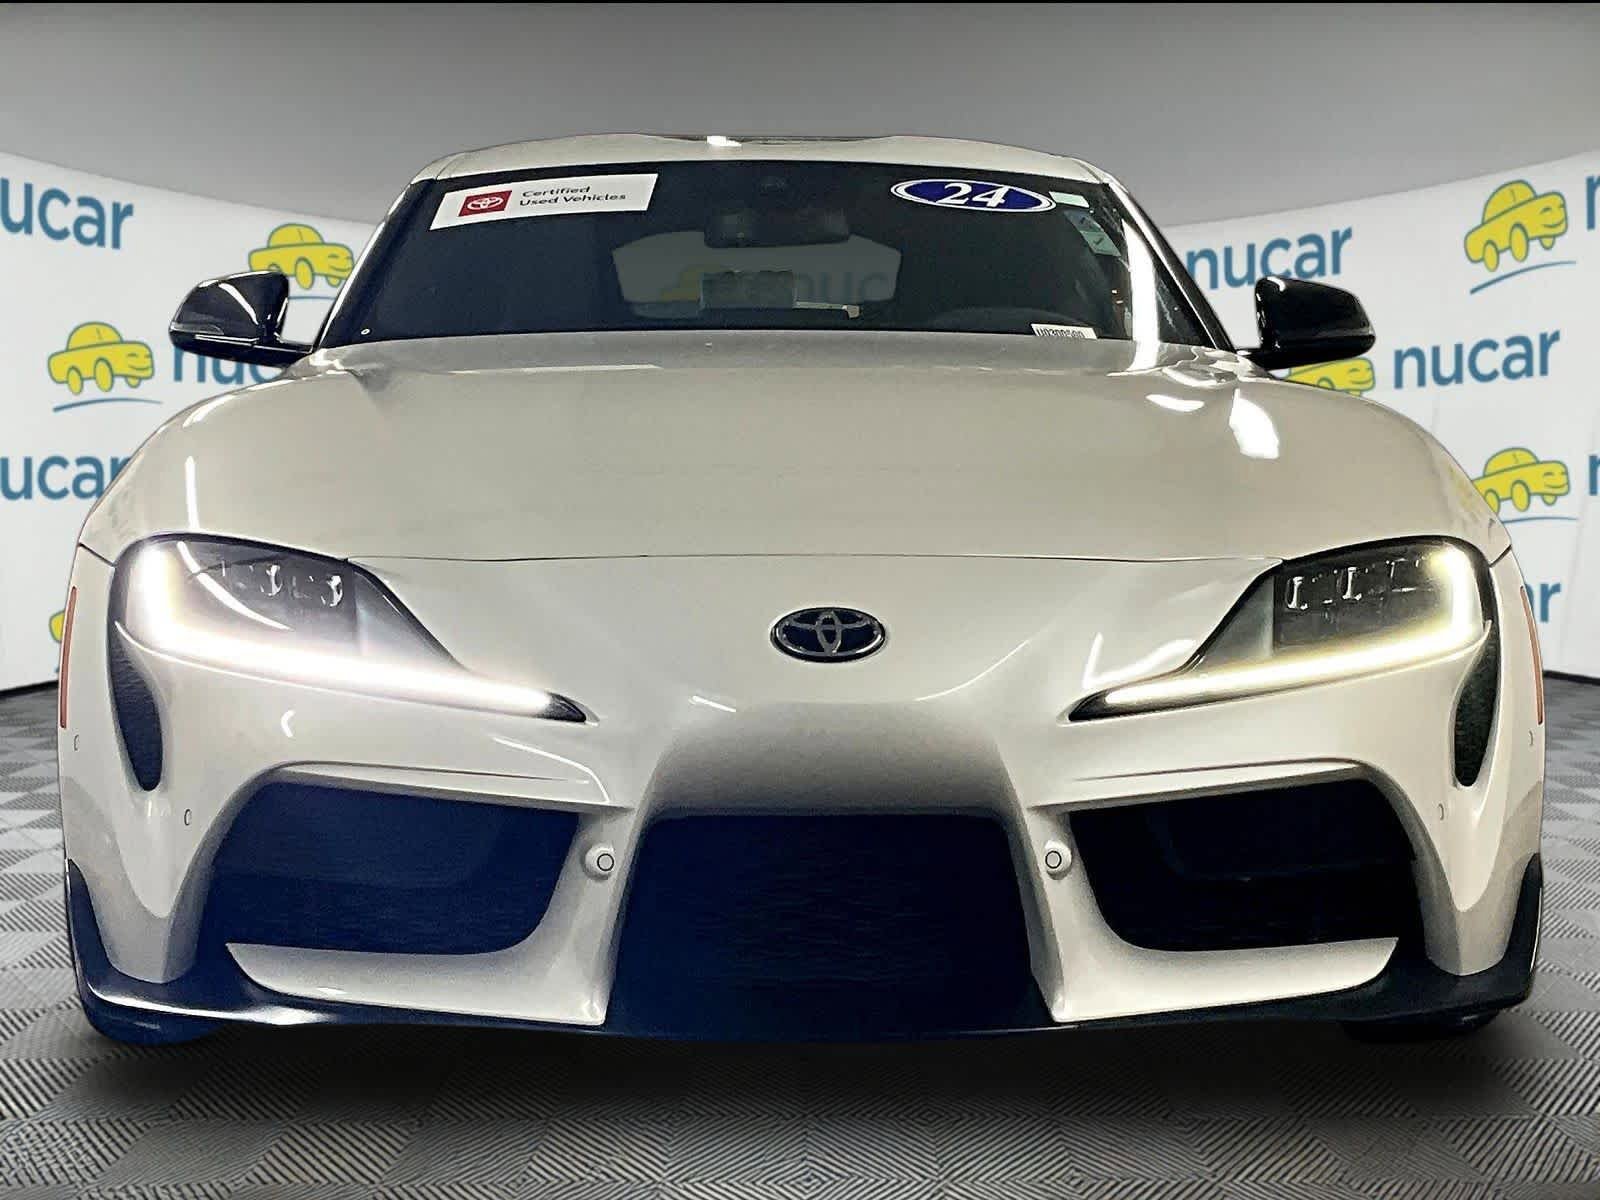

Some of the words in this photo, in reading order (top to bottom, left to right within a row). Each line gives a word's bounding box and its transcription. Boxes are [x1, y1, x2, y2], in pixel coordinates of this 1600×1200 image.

[520, 197, 558, 206] Used
[563, 193, 626, 202] Vehicles
[523, 186, 590, 197] Certified
[936, 182, 1008, 207] 24
[1186, 226, 1353, 290] nucar
[1393, 330, 1561, 389] nucar
